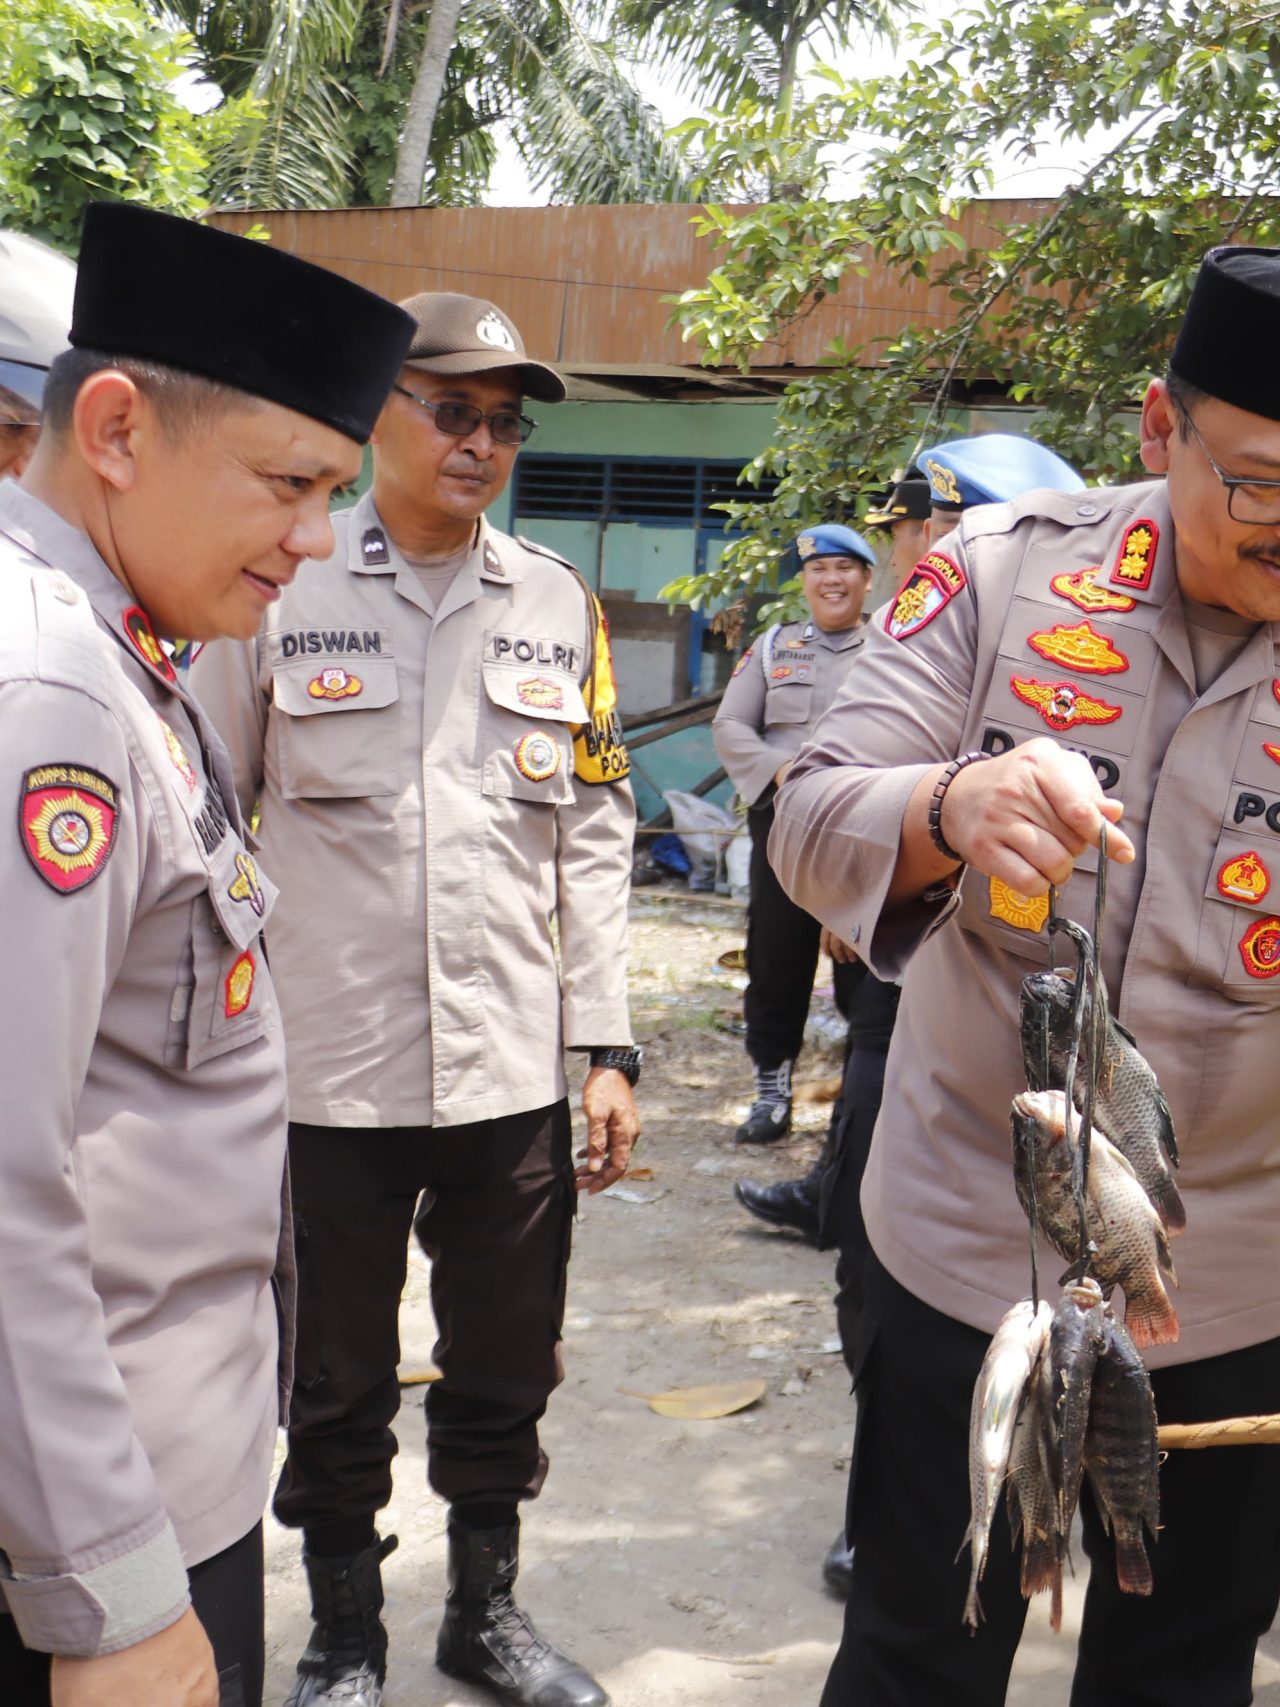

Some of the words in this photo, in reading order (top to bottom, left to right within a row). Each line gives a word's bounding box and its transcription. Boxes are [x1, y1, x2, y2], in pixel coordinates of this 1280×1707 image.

[927, 555, 961, 588] PROPAM
[281, 631, 382, 657] DISWAN
[493, 635, 574, 671] POLRI
[27, 767, 68, 790] KORPS
